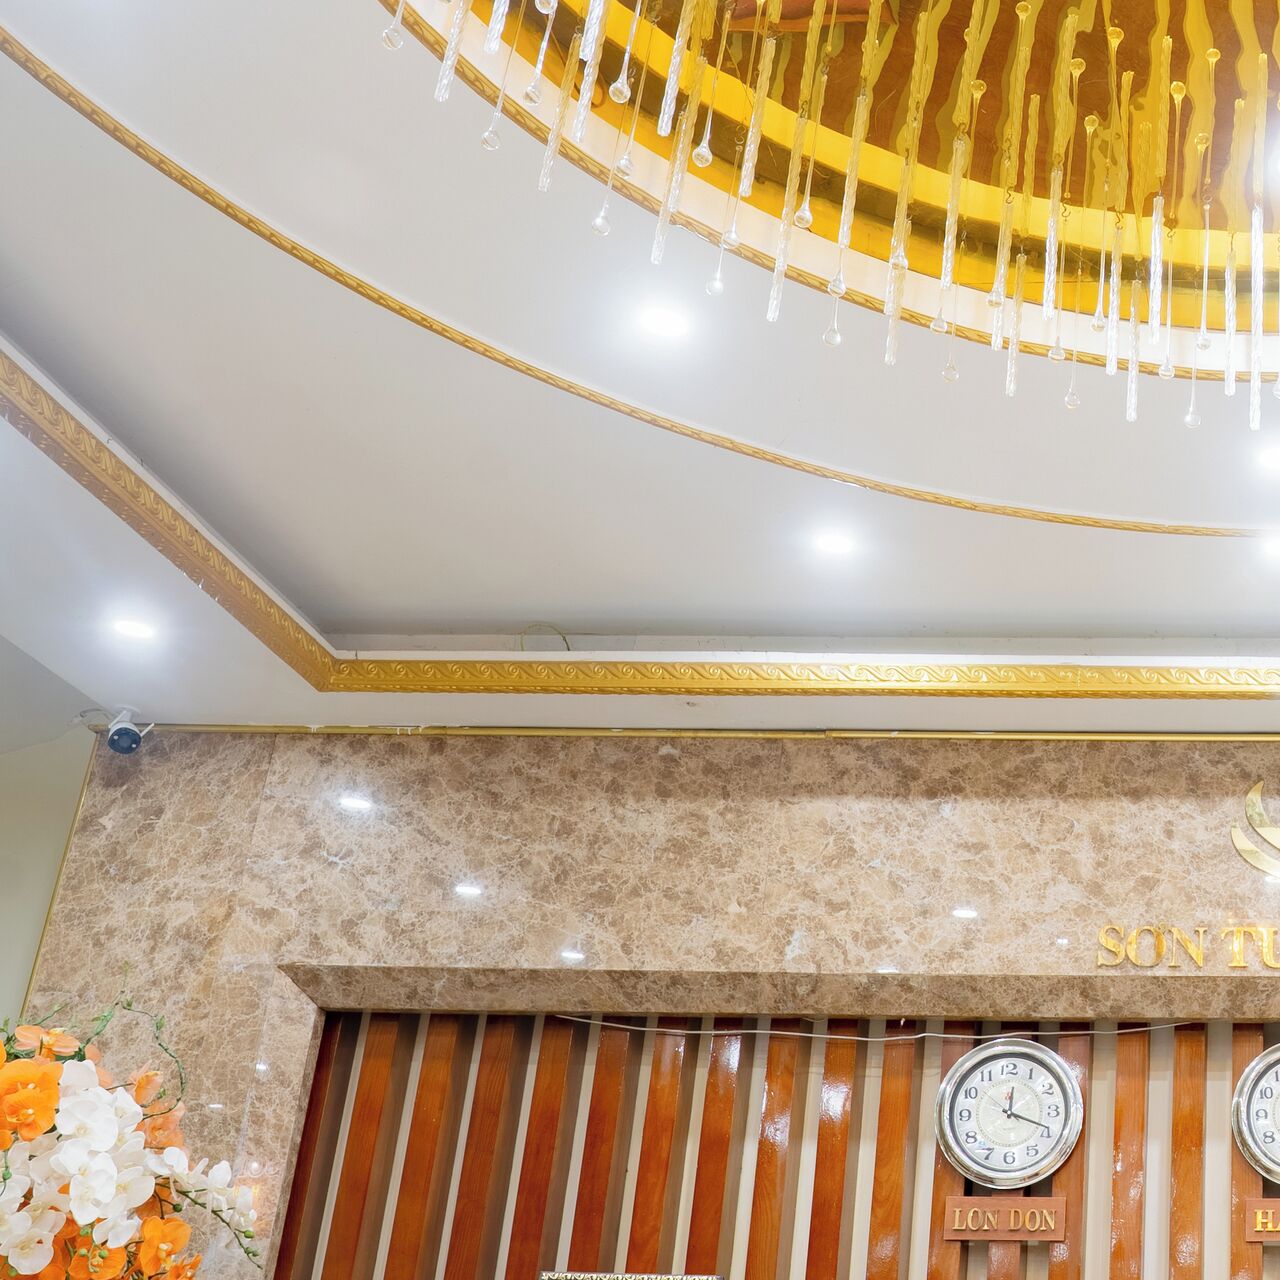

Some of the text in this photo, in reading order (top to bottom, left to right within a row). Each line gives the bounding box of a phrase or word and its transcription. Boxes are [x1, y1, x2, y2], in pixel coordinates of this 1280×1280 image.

[1000, 1063, 1019, 1075] 12
[1028, 1068, 1034, 1080] 1
[980, 1070, 992, 1082] 11
[964, 1086, 978, 1099] 10
[1042, 1082, 1054, 1095] 2
[1259, 1086, 1273, 1099] 10
[959, 1109, 972, 1121] 9
[1048, 1105, 1060, 1118] 3
[965, 1131, 978, 1144] 8
[1263, 1131, 1275, 1144] 8
[1026, 1144, 1039, 1157] 5
[1004, 1151, 1016, 1164] 6
[952, 1208, 1057, 1231] LON DON
